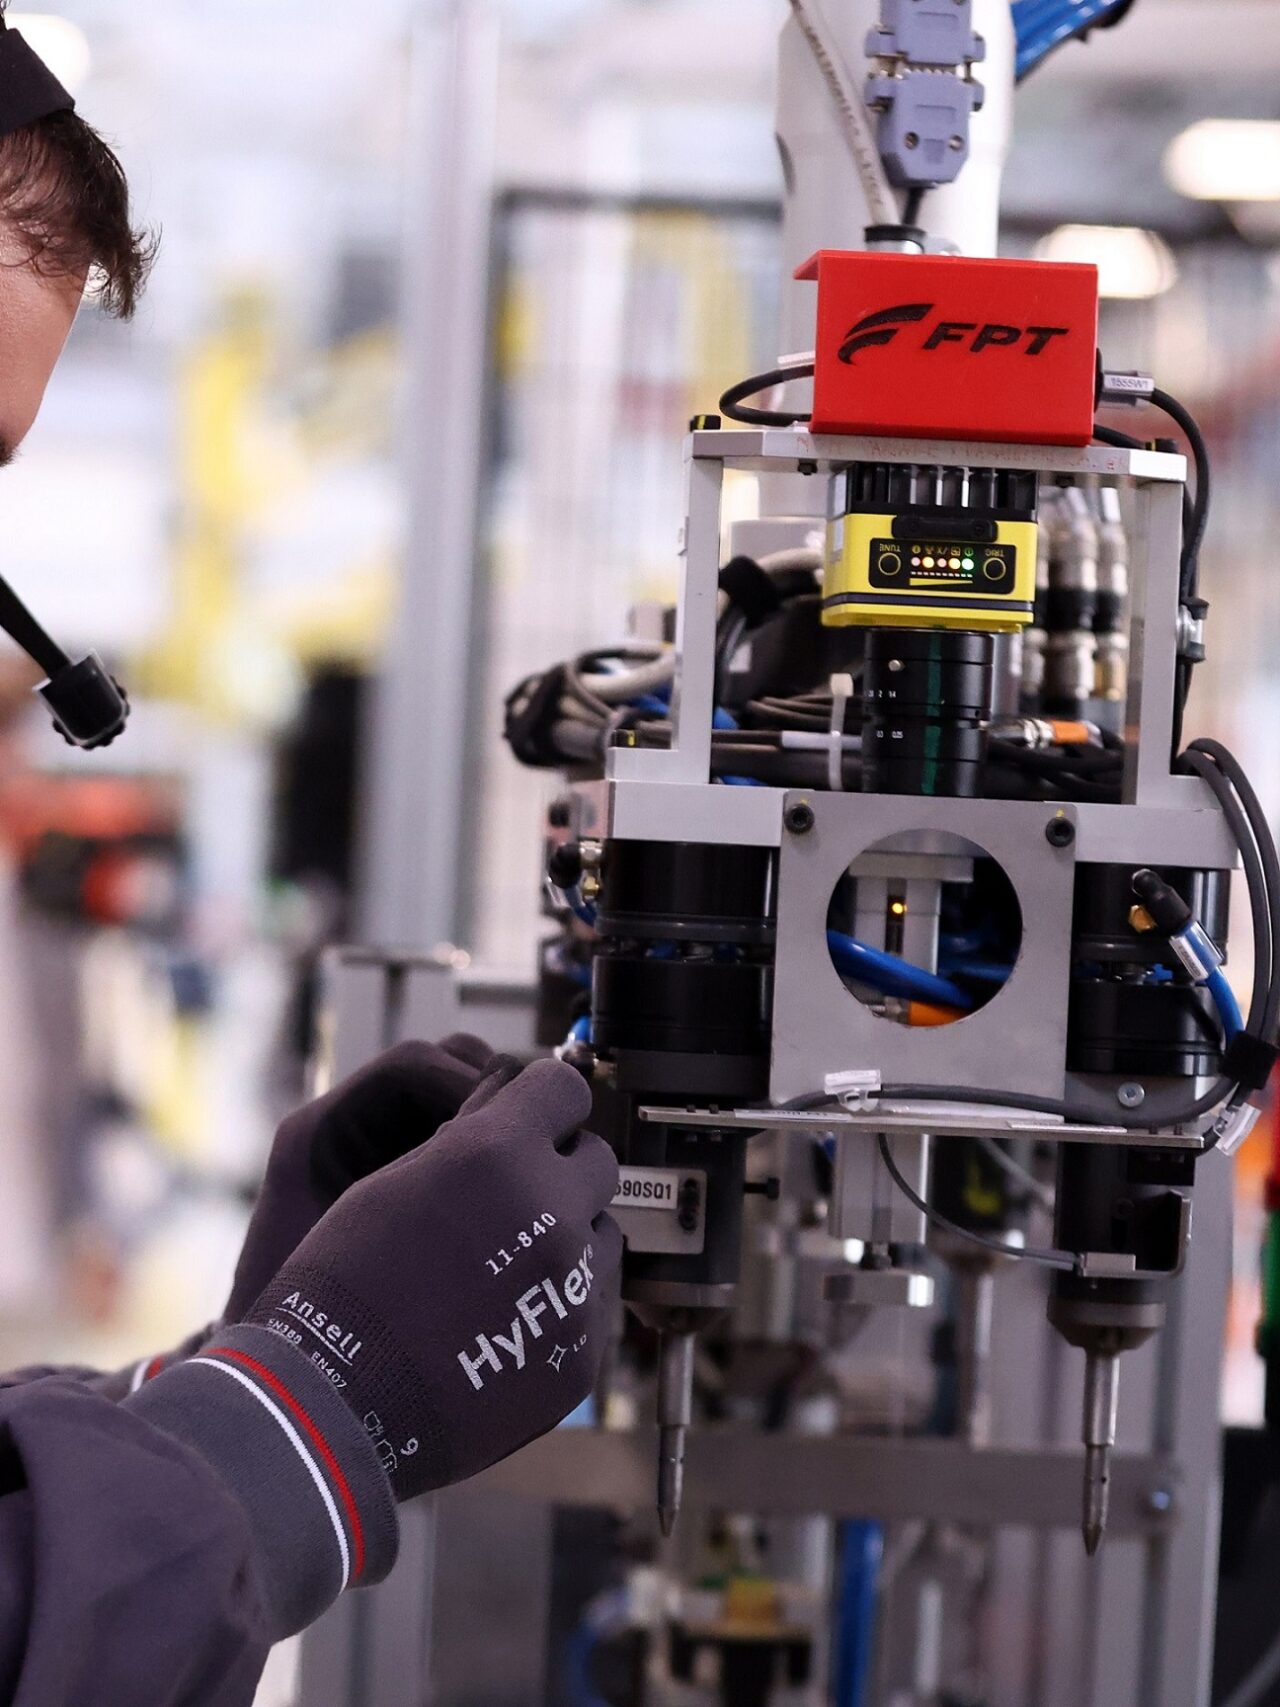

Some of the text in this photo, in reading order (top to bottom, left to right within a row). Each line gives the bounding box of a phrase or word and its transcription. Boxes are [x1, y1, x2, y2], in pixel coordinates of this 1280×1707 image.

[923, 322, 1069, 356] FPT
[880, 543, 901, 552] TUNE
[985, 548, 1004, 557] TRIG
[485, 1212, 556, 1275] 11-840
[282, 1291, 362, 1359] Ansell
[311, 1351, 347, 1388] EN407
[400, 1437, 419, 1456] 9
